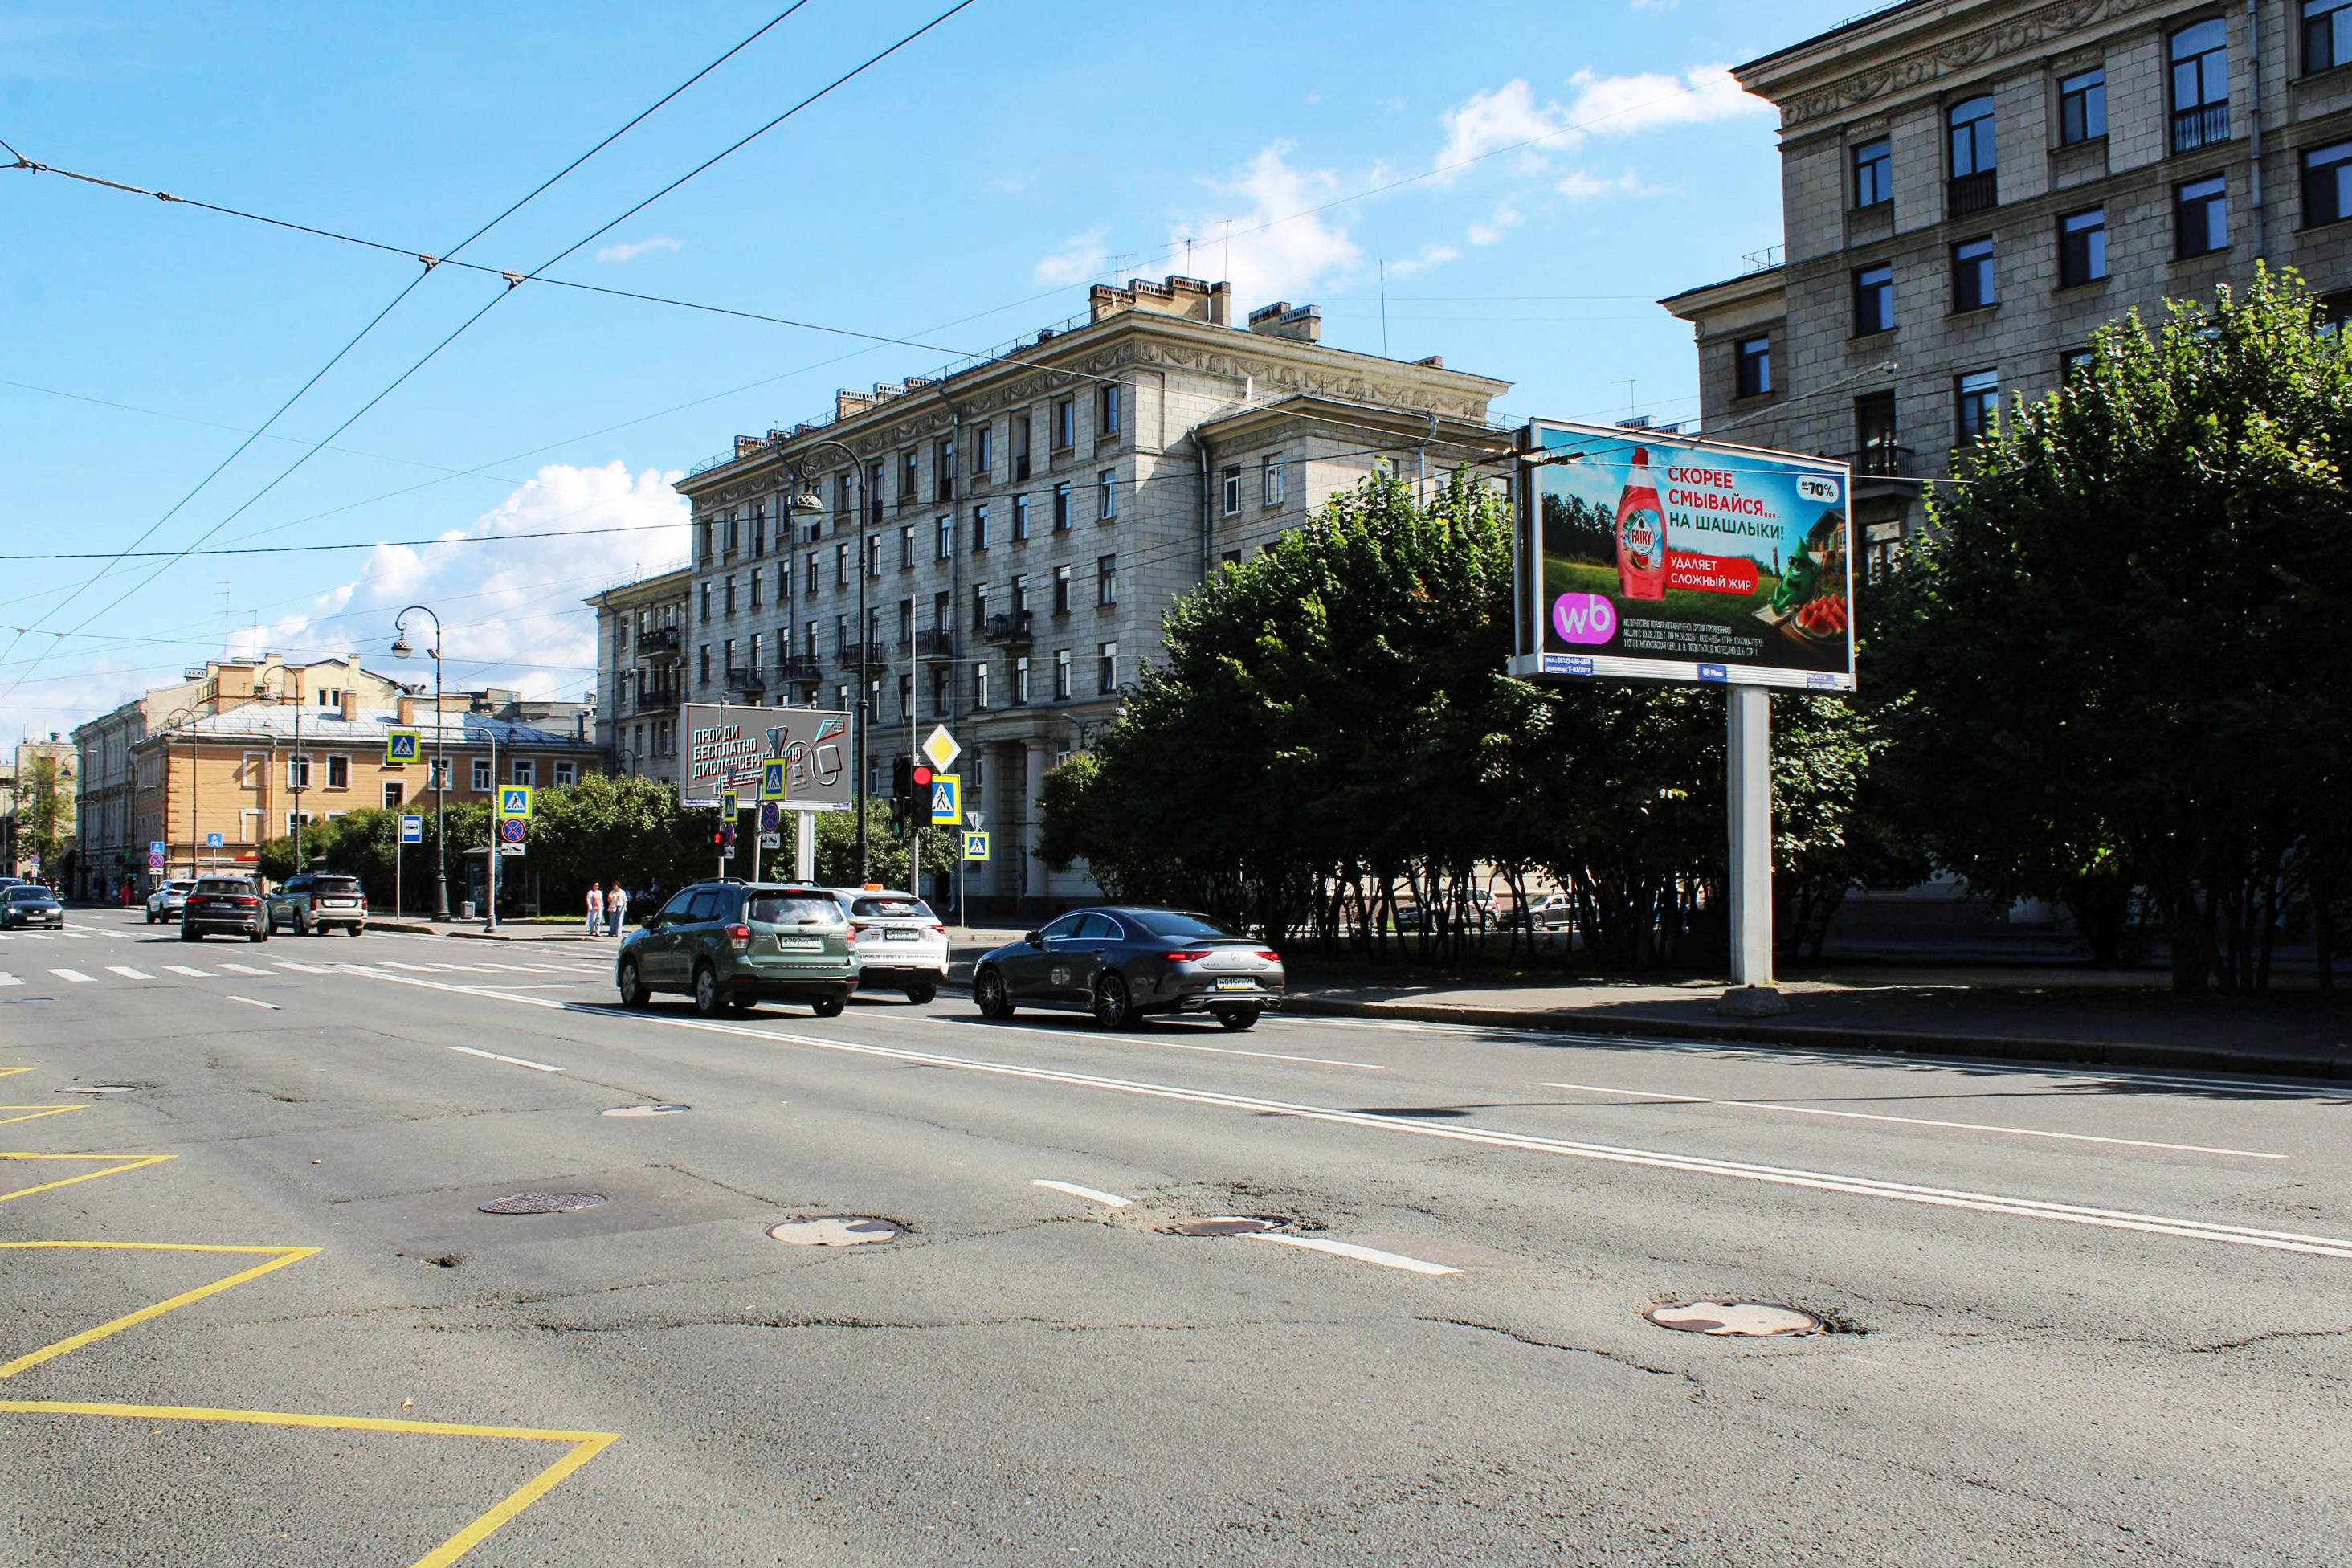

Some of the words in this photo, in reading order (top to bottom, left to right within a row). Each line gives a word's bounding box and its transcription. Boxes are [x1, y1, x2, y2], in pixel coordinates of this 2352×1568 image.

[1668, 466, 1733, 489] СКОРЕЕ
[1668, 488, 1776, 518] СМЫВАЙСЯ...
[1631, 529, 1652, 545] FAIRY
[1669, 512, 1690, 529] НА
[1696, 515, 1784, 540] ШАШЛЫКИ!
[1670, 556, 1717, 571] УДАЛЯЕТ
[1671, 573, 1725, 588] СЛОЖНЫЙ
[1729, 578, 1751, 590] ЖИР
[1559, 594, 1610, 634] wb
[693, 724, 740, 745] ПРОЙДИ
[693, 738, 758, 762] БЕСПЛАТНО
